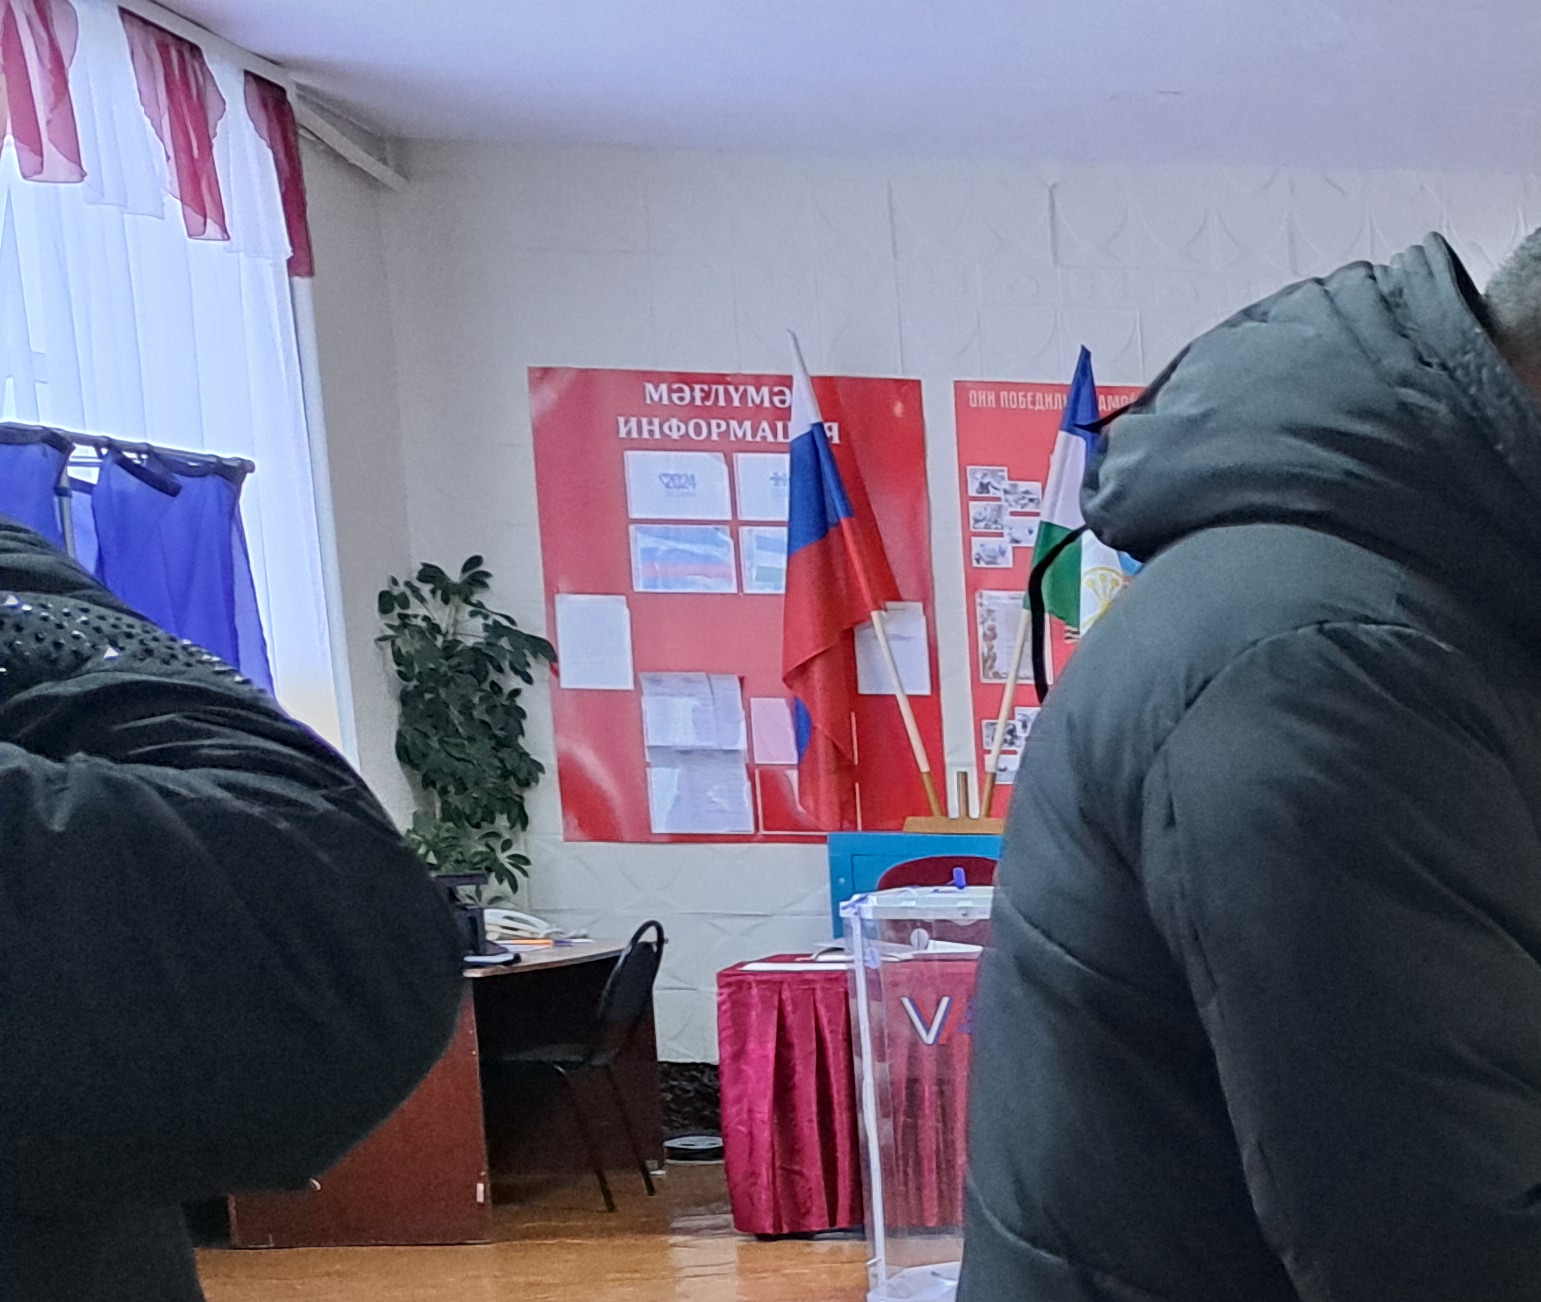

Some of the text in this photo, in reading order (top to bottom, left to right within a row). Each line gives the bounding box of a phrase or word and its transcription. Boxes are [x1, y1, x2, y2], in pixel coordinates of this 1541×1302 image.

[644, 382, 793, 409] МӘҒЛҮМӘ
[1000, 390, 1068, 412] ПОБЕДИЛ
[617, 415, 840, 444] ИНФОРМАЦЯ
